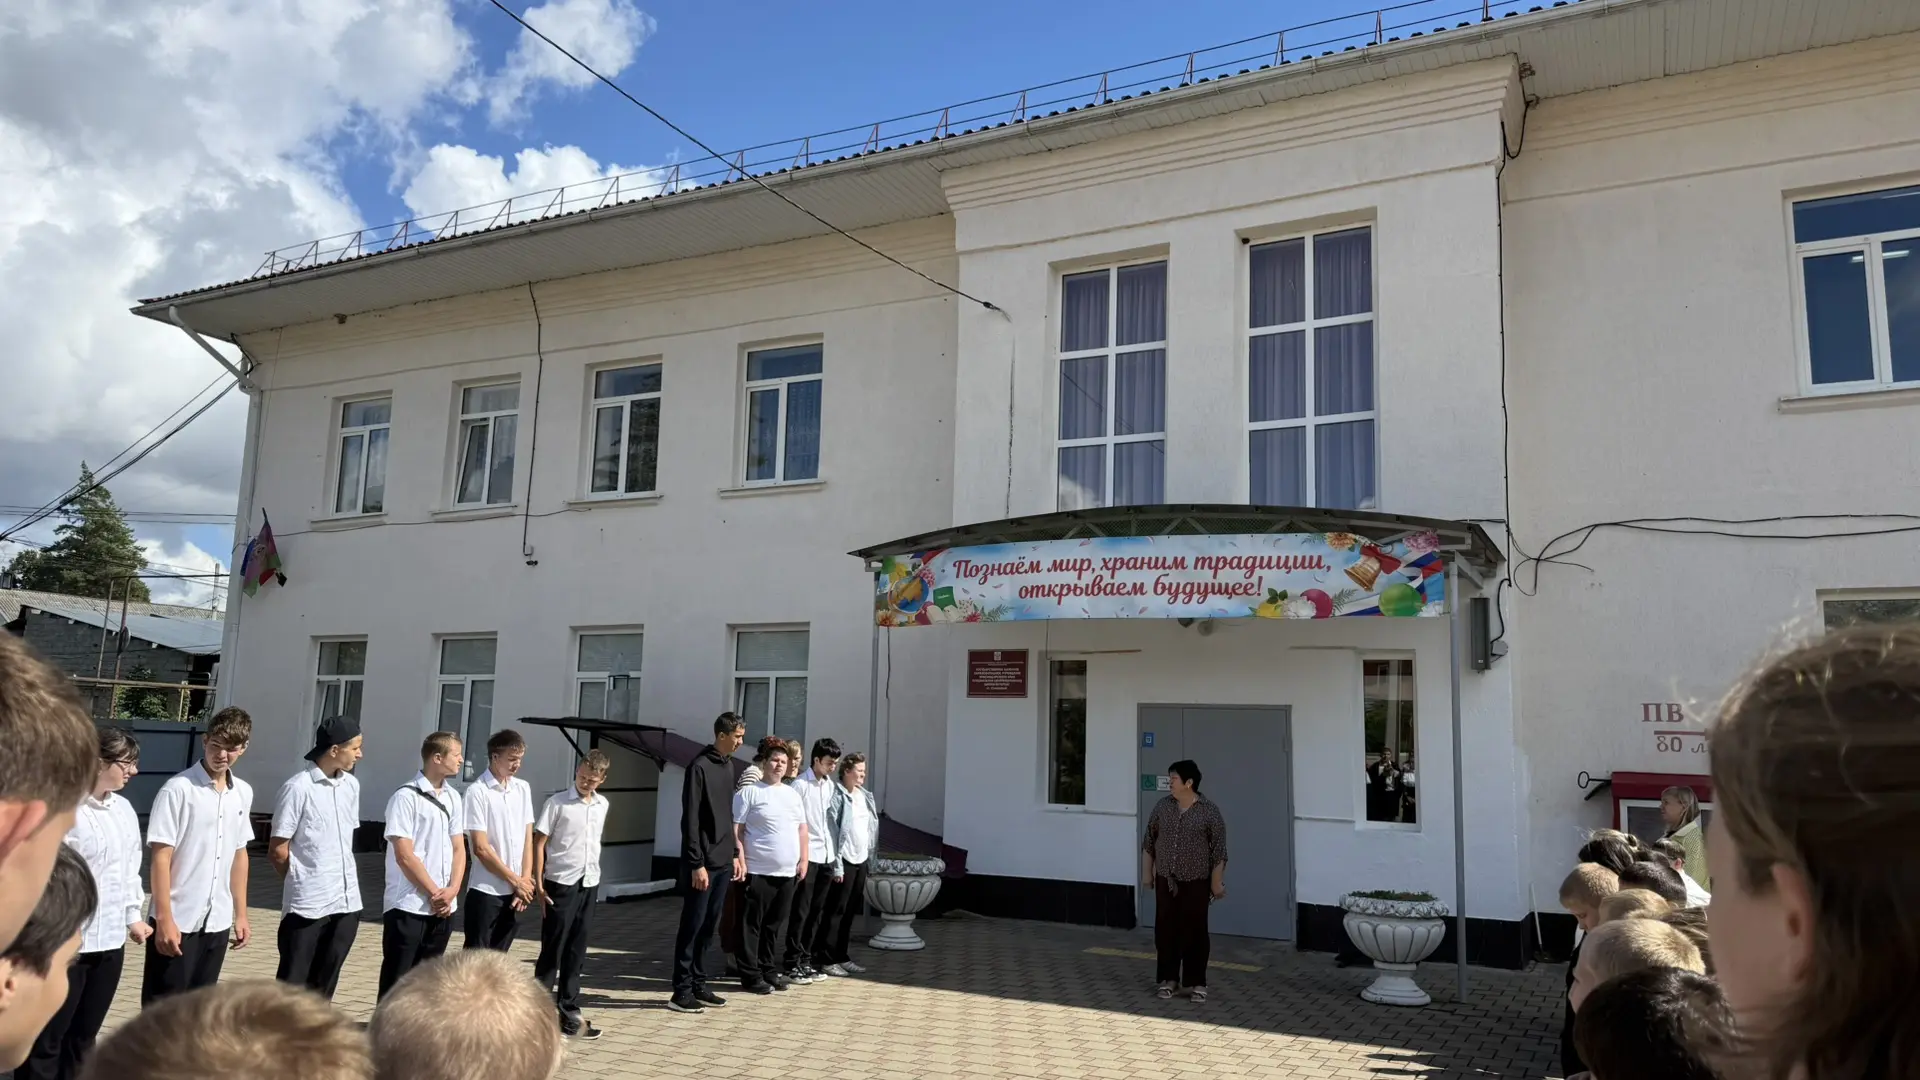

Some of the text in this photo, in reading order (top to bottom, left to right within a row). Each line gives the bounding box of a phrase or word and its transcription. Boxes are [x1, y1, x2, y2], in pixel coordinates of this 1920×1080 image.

[953, 554, 1332, 586] Познаём мир, храним традиции,
[1018, 573, 1264, 606] открываем будущее!
[1641, 702, 1684, 723] ПВ
[1656, 736, 1682, 753] 80
